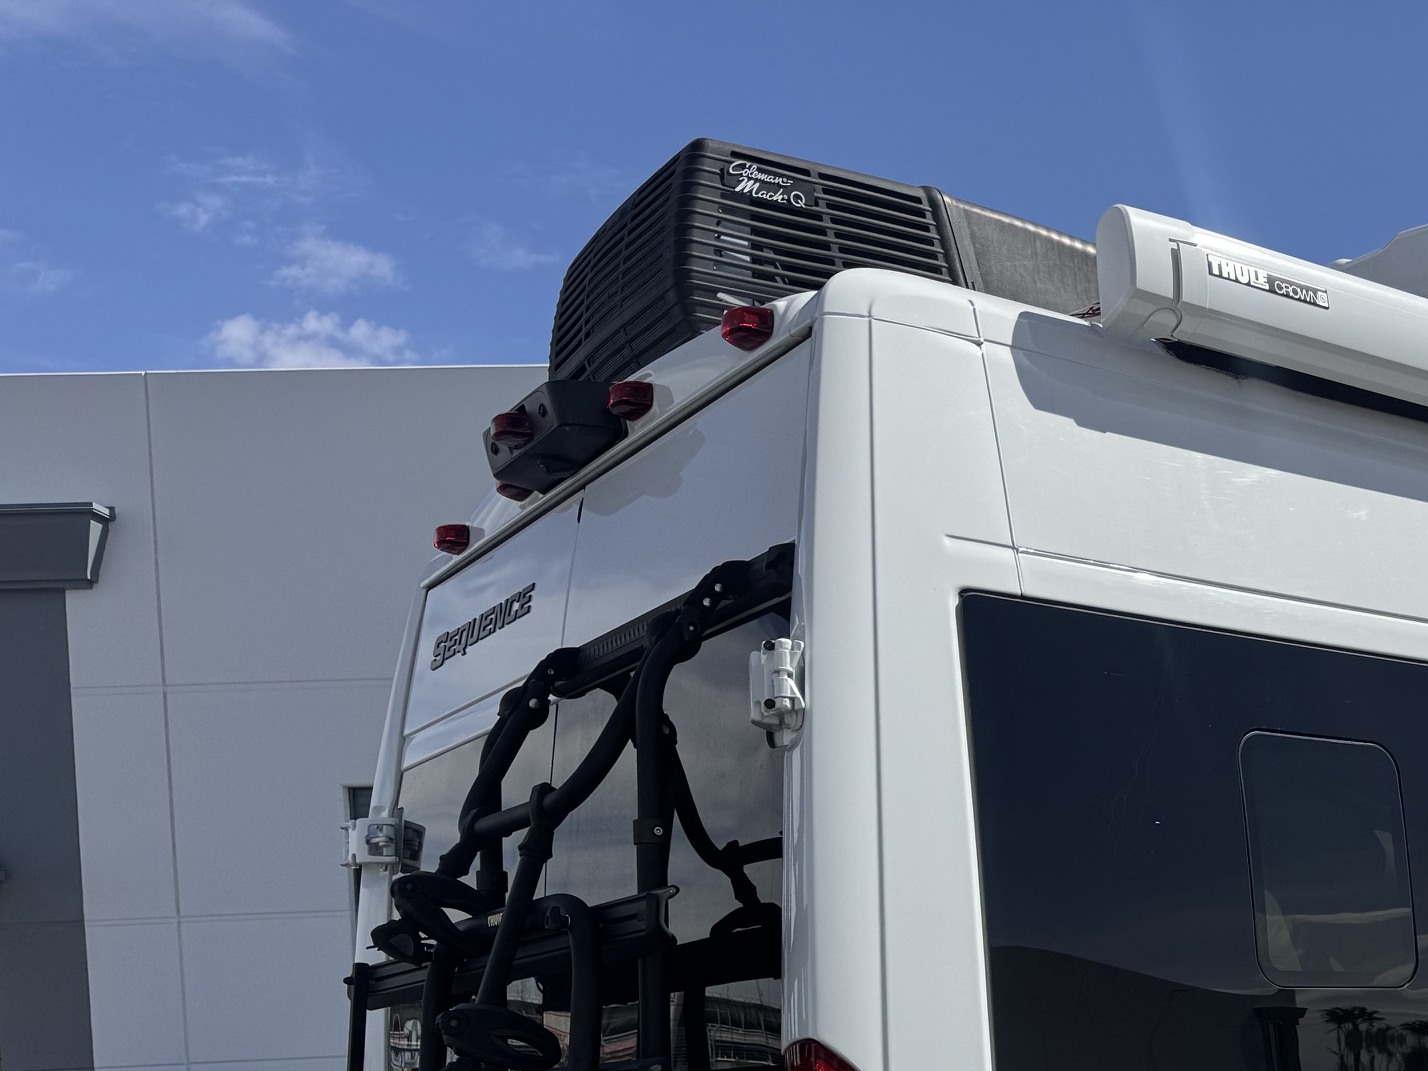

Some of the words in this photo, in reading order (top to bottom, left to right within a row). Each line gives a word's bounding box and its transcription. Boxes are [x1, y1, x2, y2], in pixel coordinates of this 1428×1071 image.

[790, 191, 805, 208] Q
[1208, 254, 1269, 290] THULE
[1274, 280, 1321, 305] CROWN
[430, 582, 536, 671] SEQUENCE
